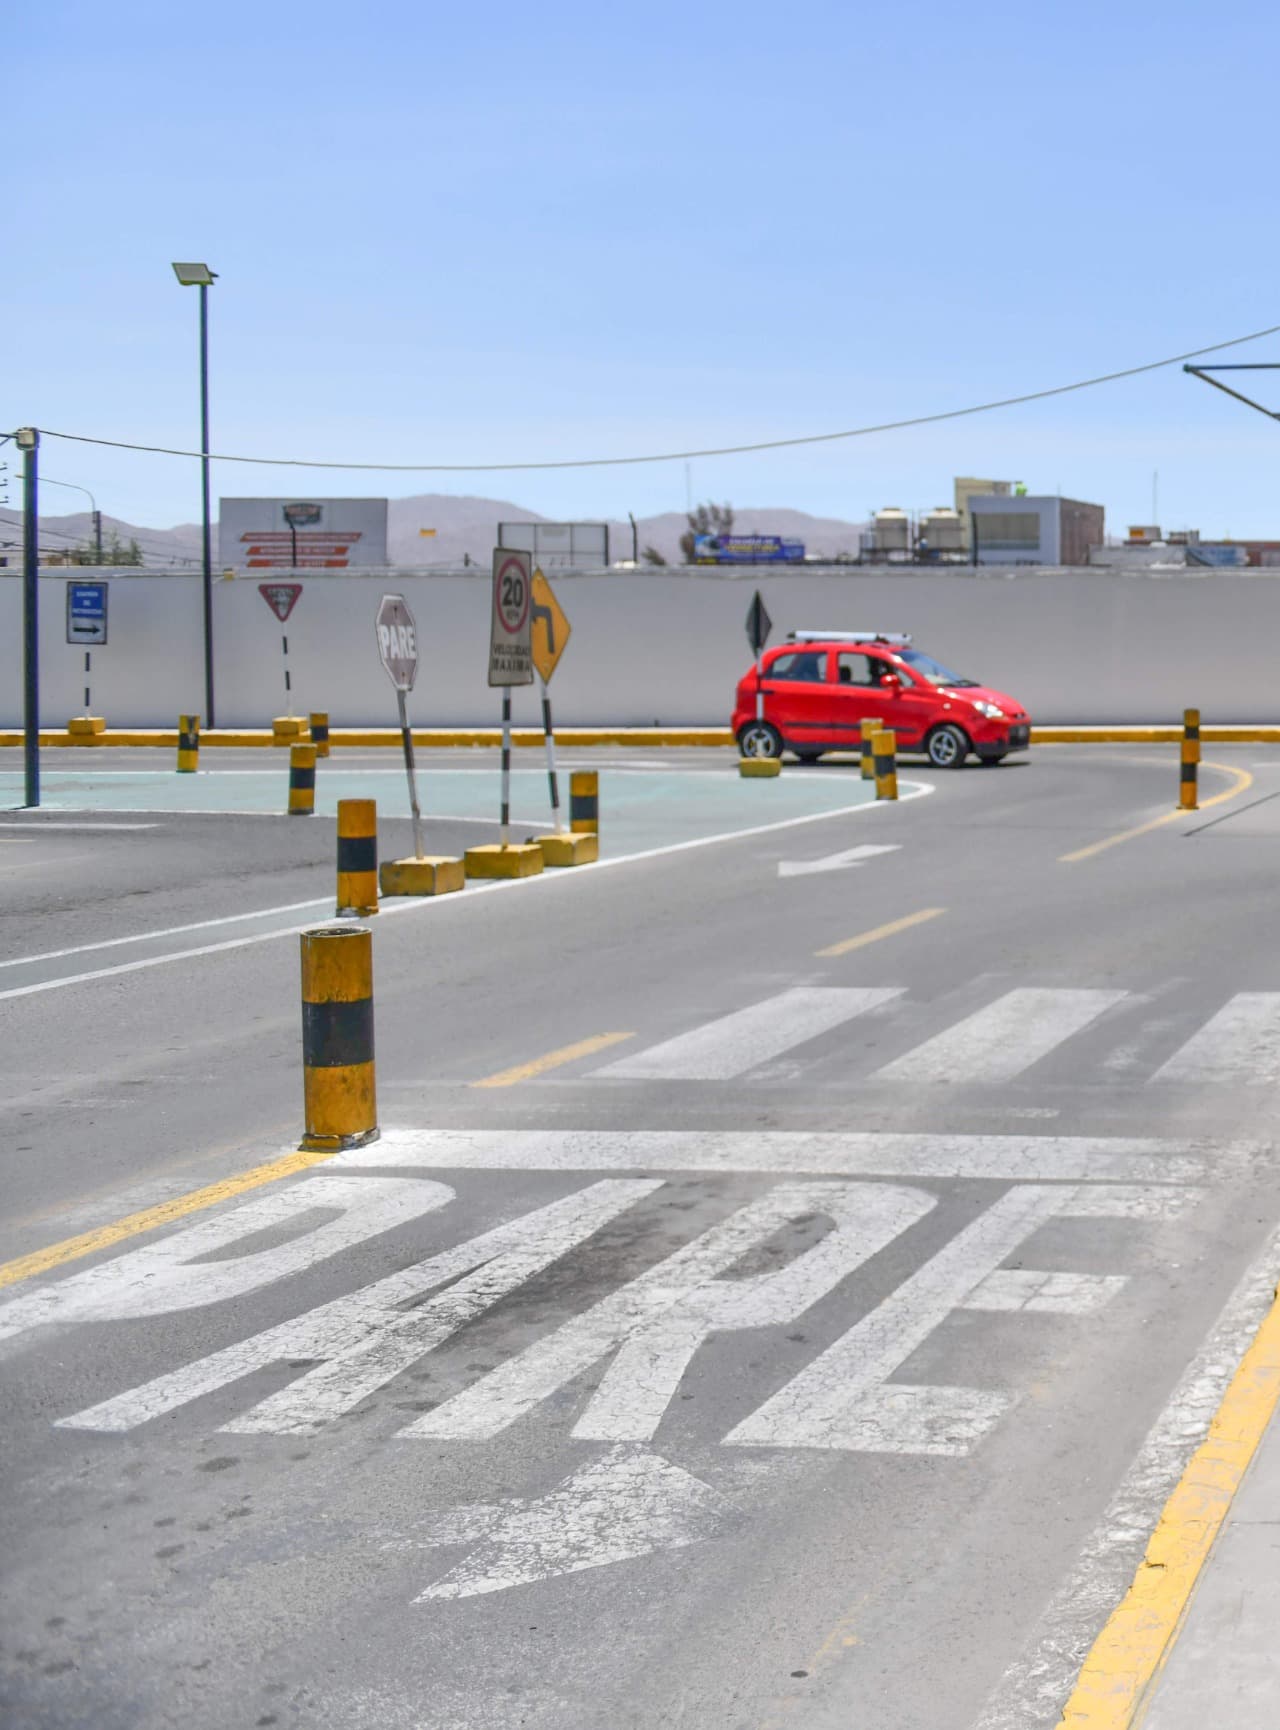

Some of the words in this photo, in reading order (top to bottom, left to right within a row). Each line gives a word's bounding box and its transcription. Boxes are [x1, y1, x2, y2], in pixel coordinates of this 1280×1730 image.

[502, 576, 523, 608] 20
[378, 624, 416, 660] PARE
[0, 1176, 1205, 1456] PARE
